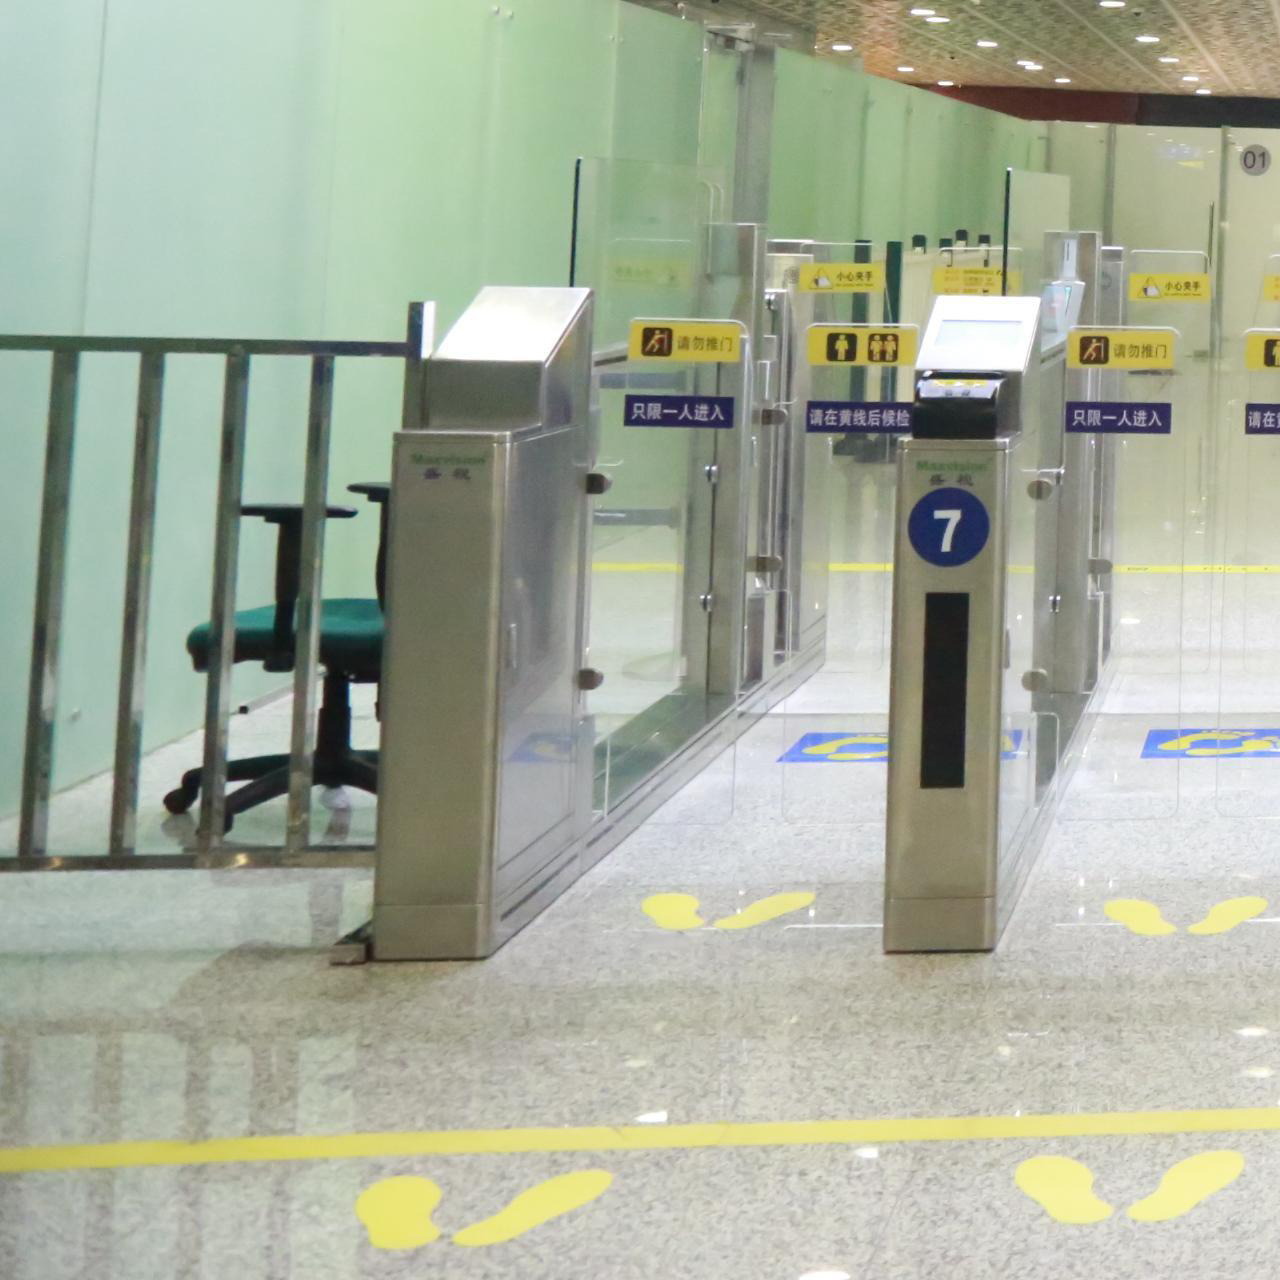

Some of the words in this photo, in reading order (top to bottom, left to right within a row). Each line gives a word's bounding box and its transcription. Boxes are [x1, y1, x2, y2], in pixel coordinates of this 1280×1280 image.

[1243, 150, 1267, 169] 01
[677, 335, 733, 352] 请勿推门
[1113, 343, 1168, 360] 请勿推门
[631, 402, 725, 422] 只限一人进入
[809, 408, 910, 427] 请在黄线后候检
[1072, 410, 1162, 428] 只限一人进入
[933, 509, 962, 553] 7
